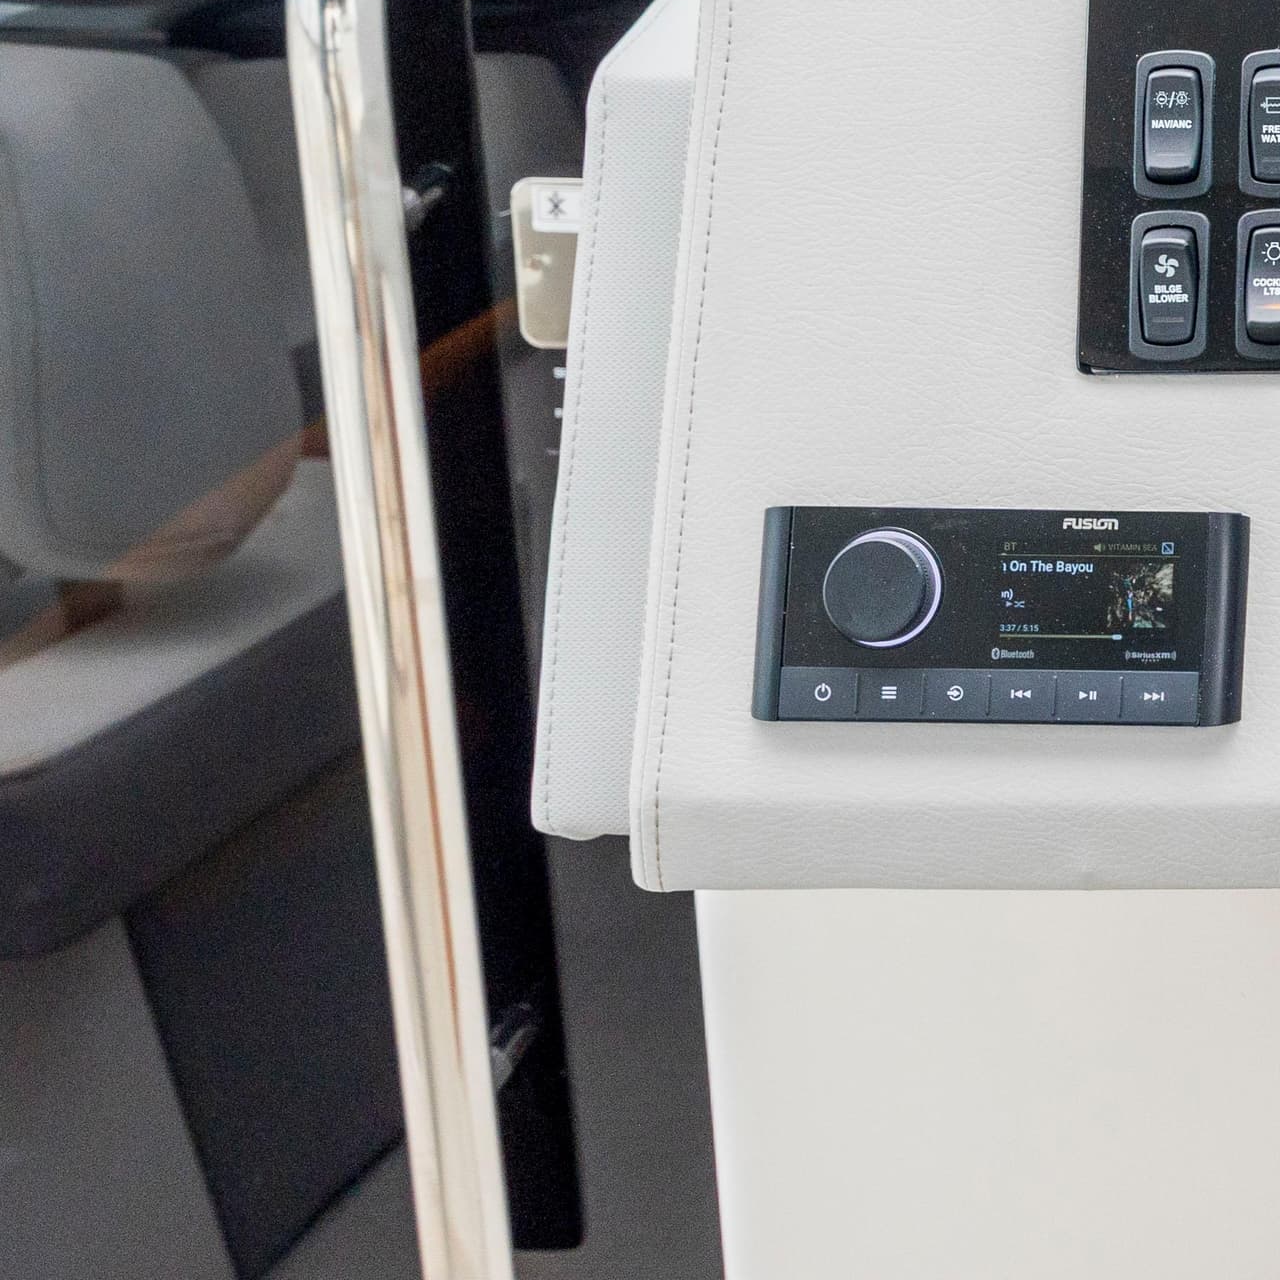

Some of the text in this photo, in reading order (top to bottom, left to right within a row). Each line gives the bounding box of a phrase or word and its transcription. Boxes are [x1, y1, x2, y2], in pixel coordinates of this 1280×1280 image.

[1154, 284, 1183, 294] BILGE
[1263, 287, 1280, 296] LTS
[1148, 294, 1189, 303] BLOWER
[1009, 560, 1027, 572] On
[1030, 560, 1054, 572] The
[1056, 560, 1094, 575] Bayou
[1000, 649, 1035, 659] Bluetooth
